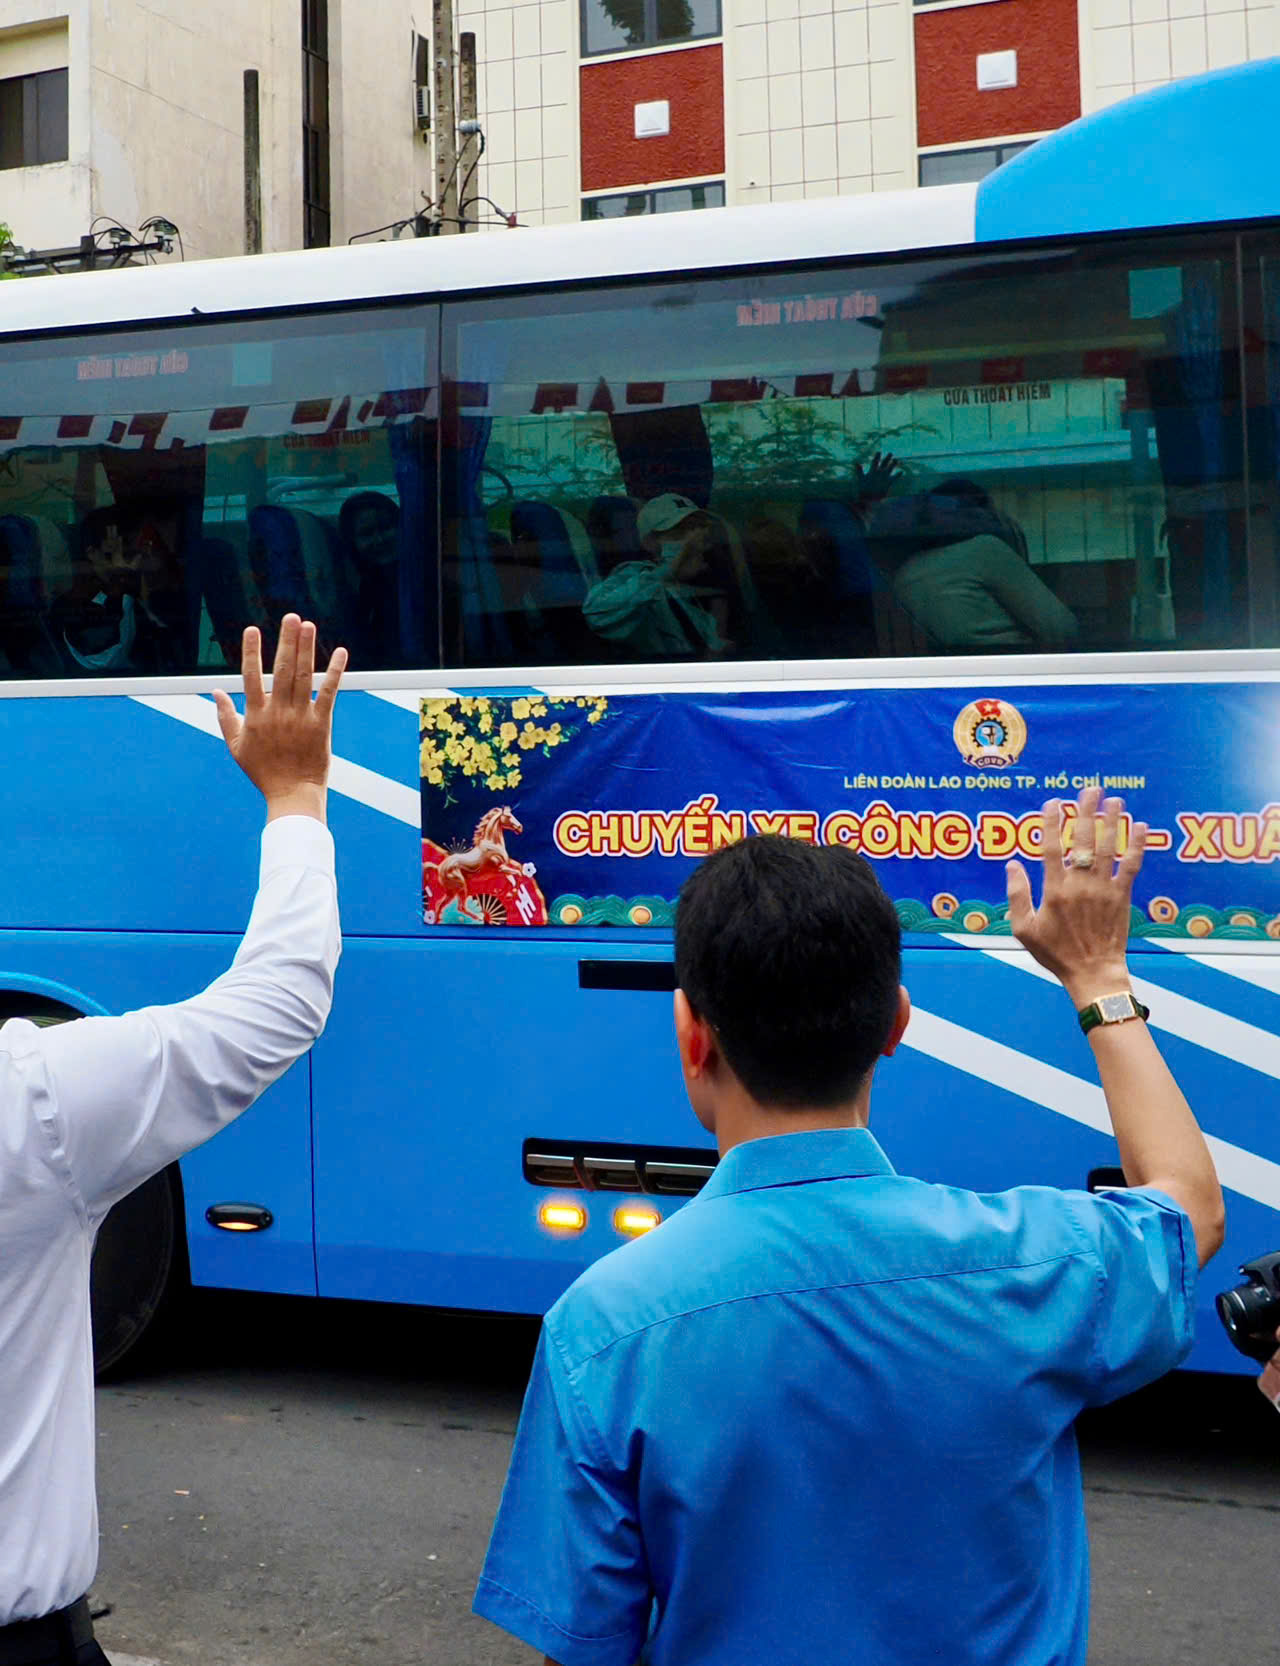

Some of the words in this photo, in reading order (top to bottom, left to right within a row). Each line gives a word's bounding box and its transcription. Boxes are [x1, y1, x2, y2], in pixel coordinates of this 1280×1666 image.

[843, 773, 878, 789] LIÊN
[881, 772, 926, 789] ĐOÀN
[929, 776, 962, 789] LAO
[964, 773, 1011, 792] ĐỘNG
[1015, 775, 1041, 789] TP.
[1103, 775, 1145, 789] MINH
[554, 795, 746, 856] CHUYẾN
[822, 801, 974, 860] CÔNG
